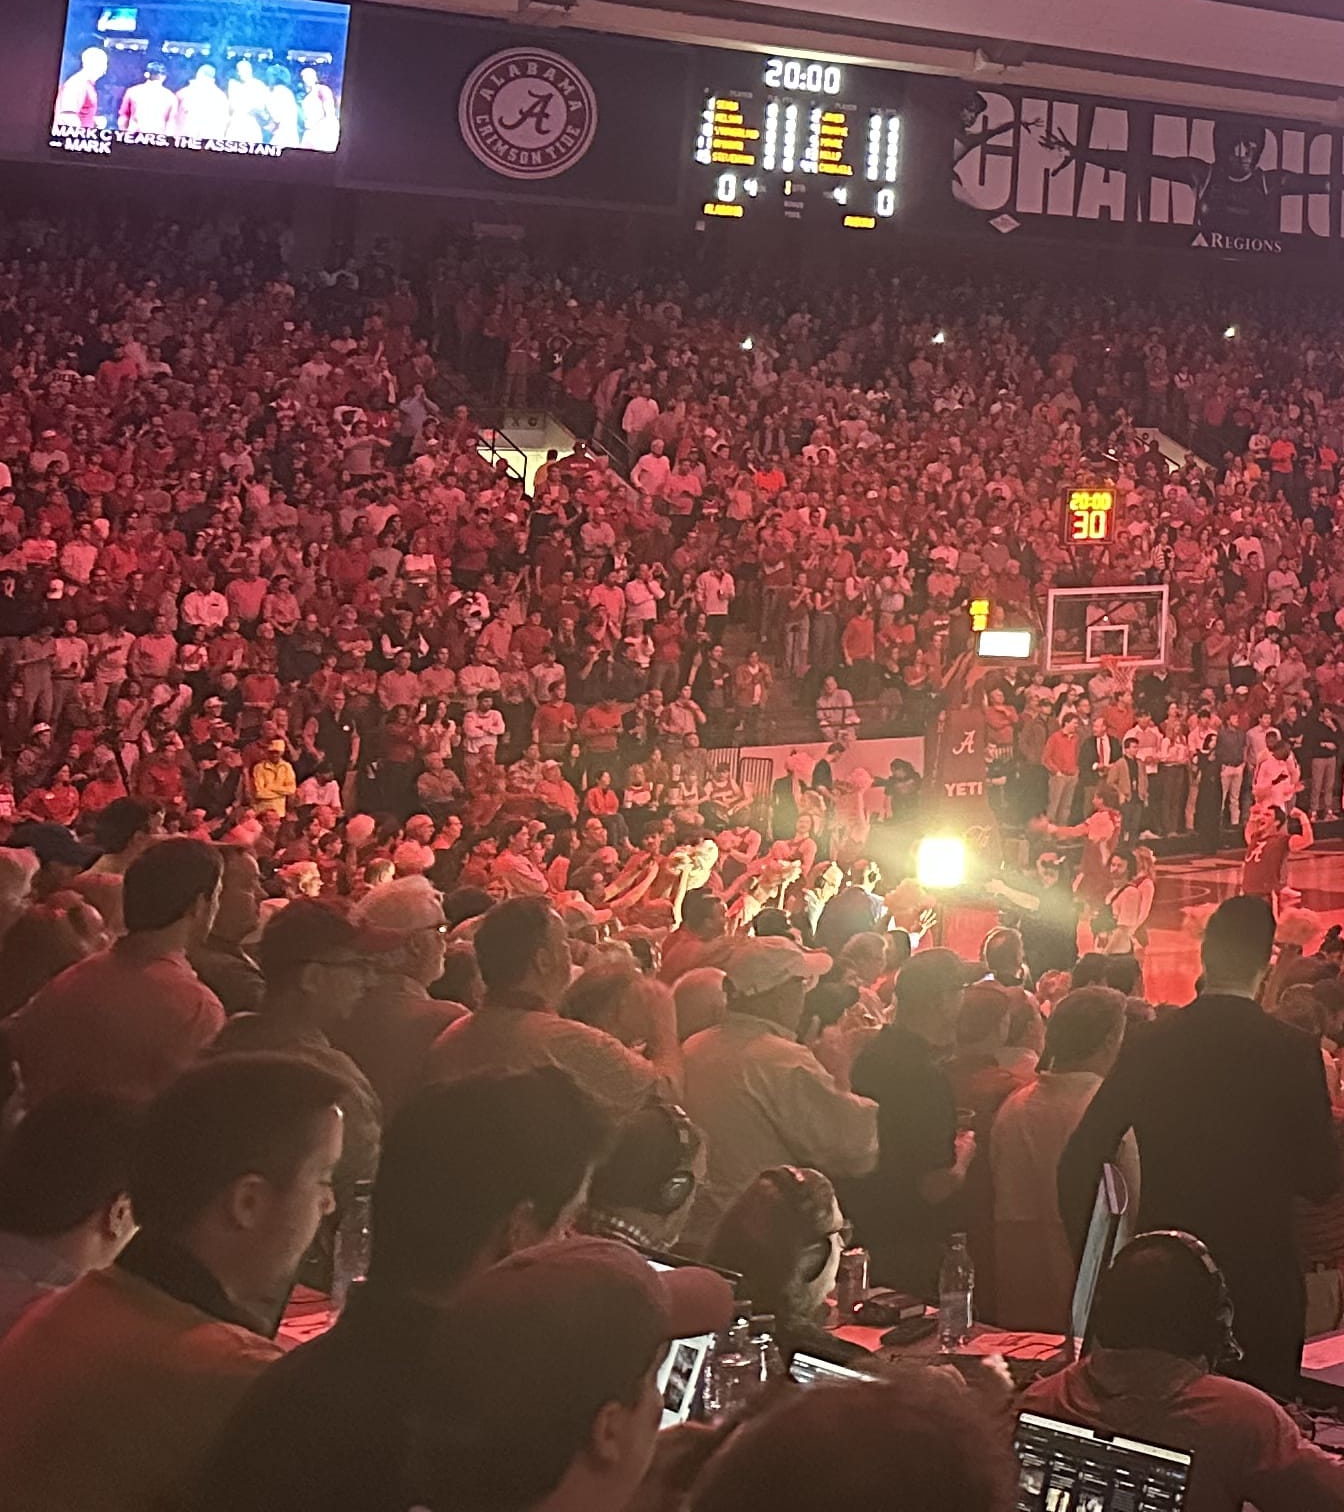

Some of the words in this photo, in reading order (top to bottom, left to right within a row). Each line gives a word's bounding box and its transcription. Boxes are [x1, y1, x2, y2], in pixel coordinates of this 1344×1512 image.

[479, 62, 583, 112] ALABAMA
[765, 59, 840, 94] 20:00
[51, 124, 98, 141] MARK
[174, 135, 201, 151] THE
[205, 138, 283, 157] ASSISTANT
[64, 139, 111, 155] MARK
[476, 115, 542, 165] CRIMSON
[544, 125, 581, 159] TIDE
[717, 174, 736, 202] 0
[1070, 492, 1112, 511] 20:00
[1073, 510, 1106, 539] 30
[944, 781, 983, 797] YETI
